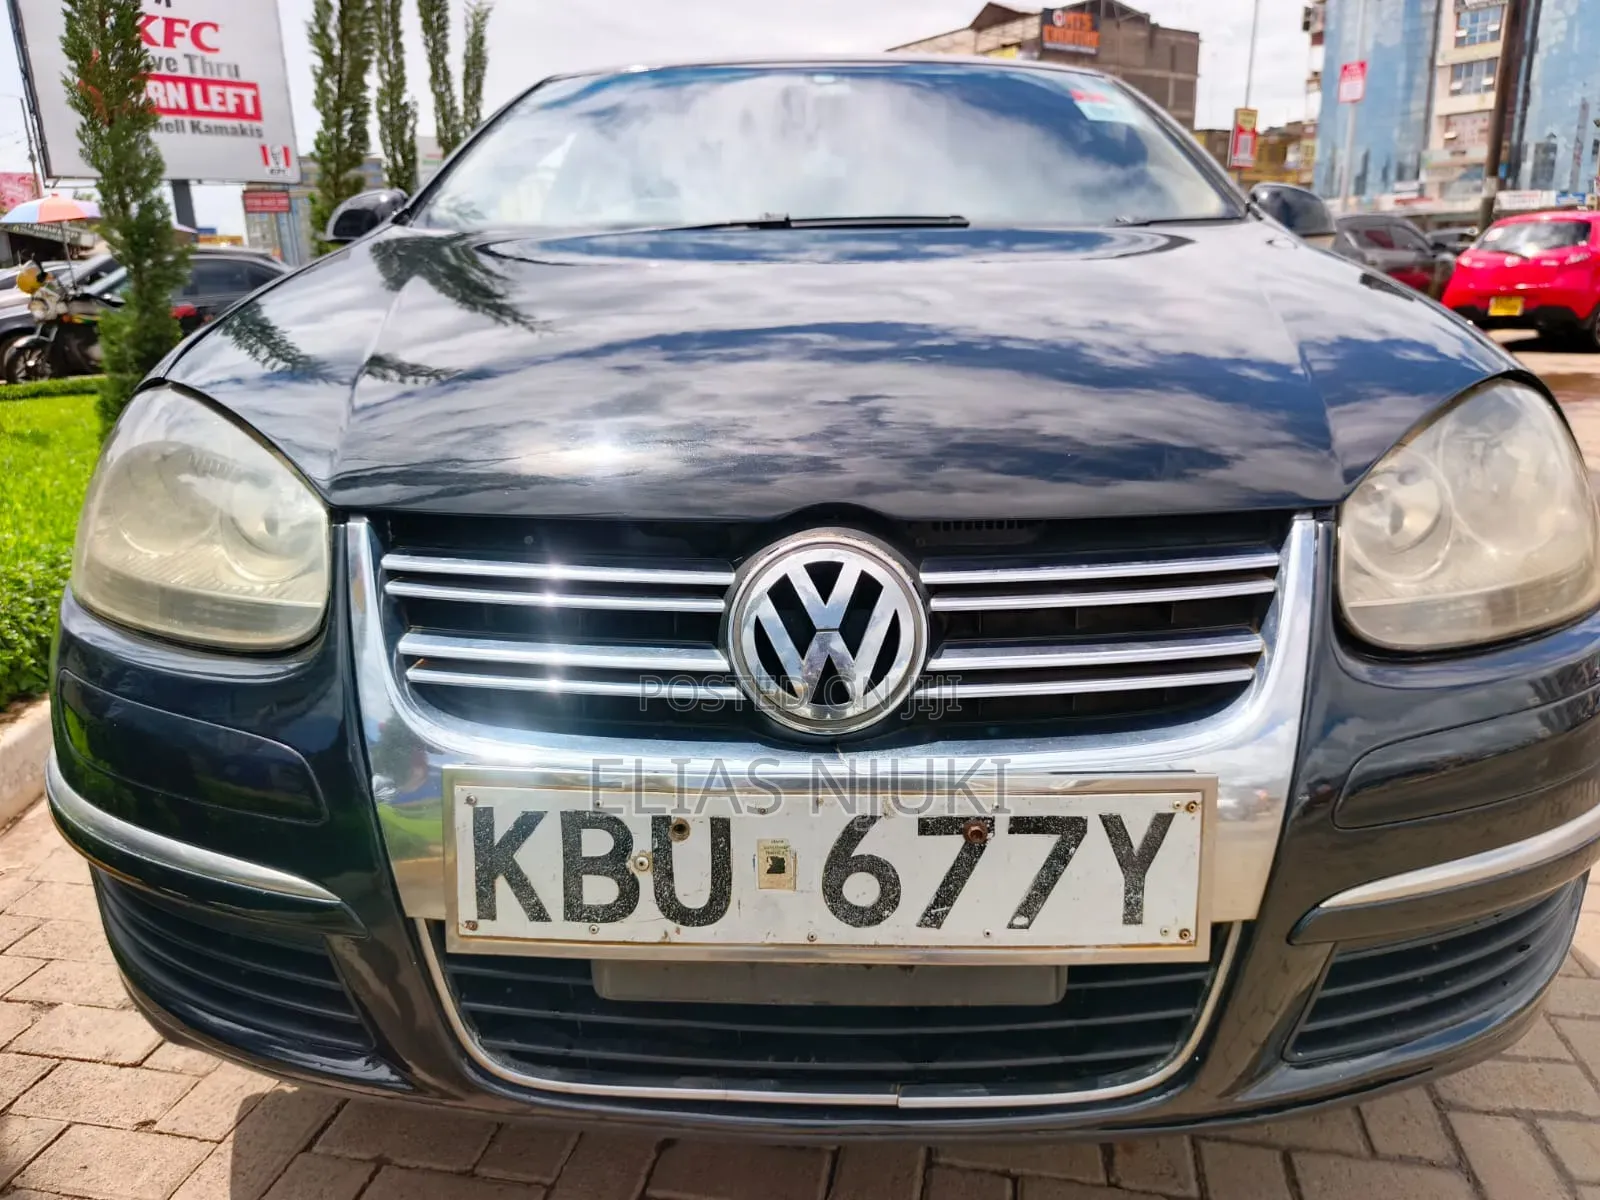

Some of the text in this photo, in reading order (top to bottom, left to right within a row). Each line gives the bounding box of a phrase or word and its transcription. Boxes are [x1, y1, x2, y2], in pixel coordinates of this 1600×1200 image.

[139, 14, 221, 54] KFC
[183, 53, 240, 79] Thru
[191, 83, 257, 115] LEFT
[190, 120, 264, 138] Kamakis
[472, 806, 1177, 930] KBU 677Y
